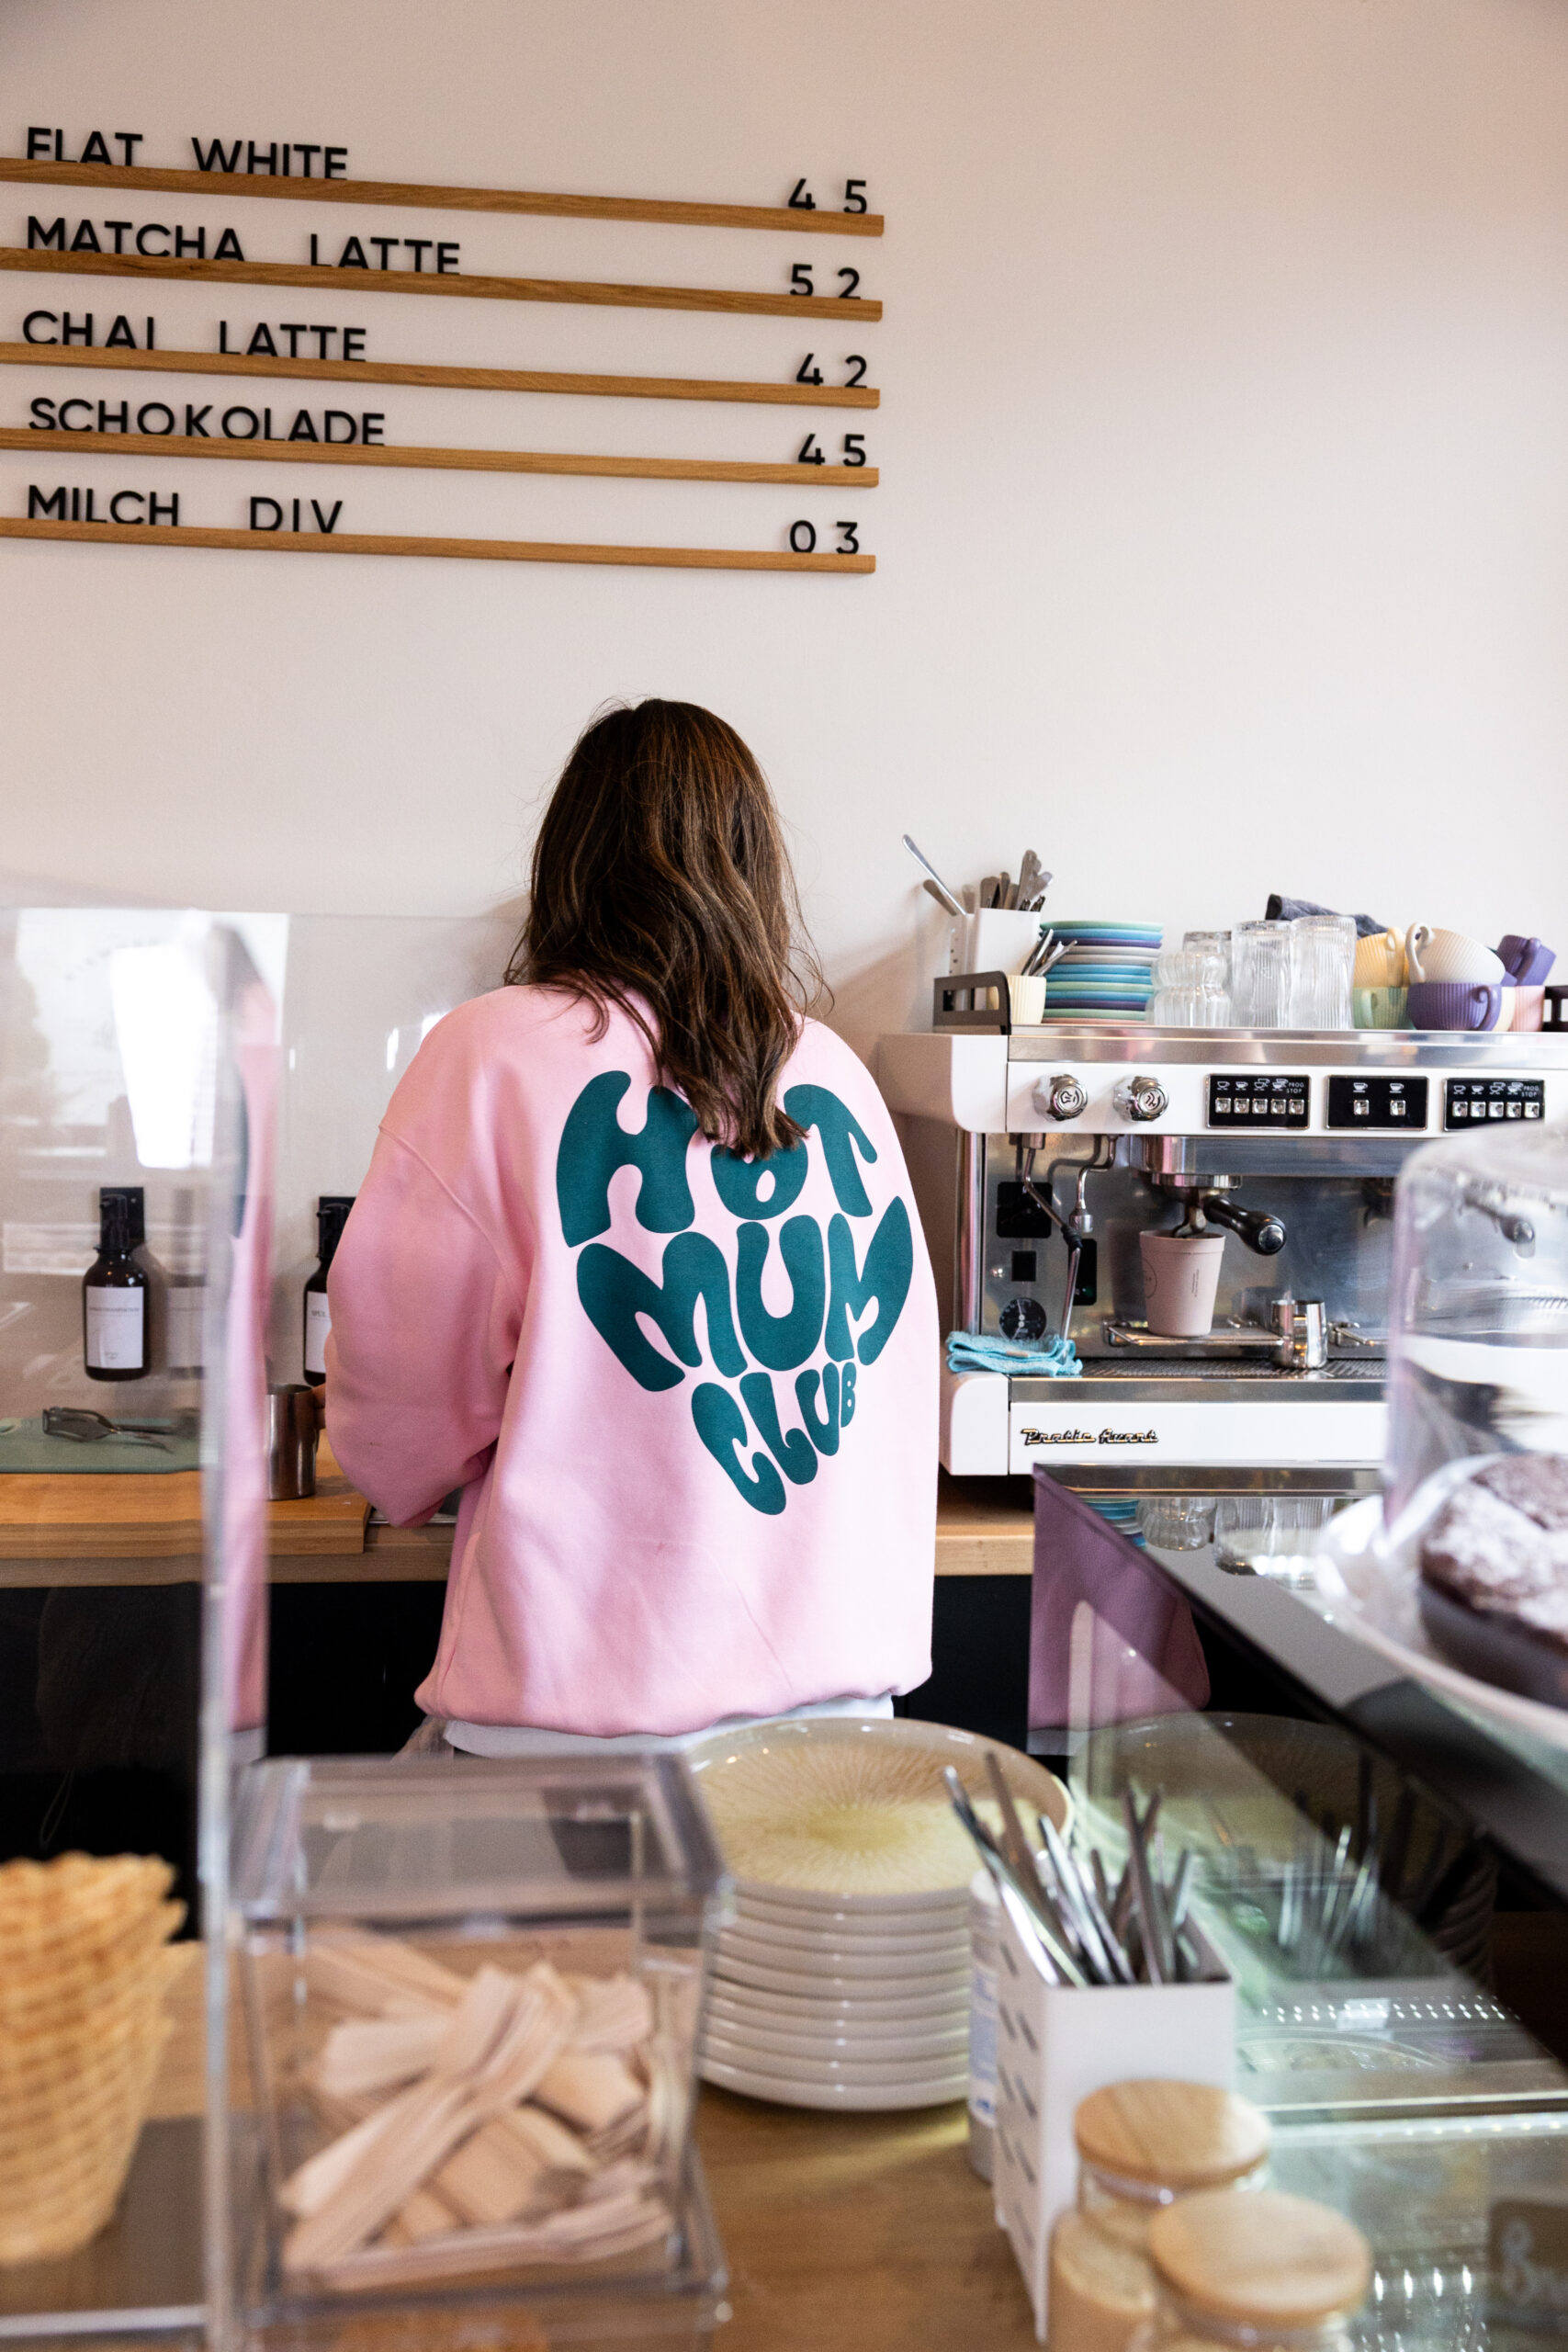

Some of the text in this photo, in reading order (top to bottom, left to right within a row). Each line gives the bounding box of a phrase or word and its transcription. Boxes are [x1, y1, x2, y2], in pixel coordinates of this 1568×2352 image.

[27, 127, 143, 167] FLAT
[191, 137, 348, 180] WHITE
[27, 216, 245, 262] MATCHA
[310, 233, 460, 276] LATTE
[22, 310, 154, 351] CHAI
[220, 321, 367, 363] LATTE
[28, 397, 385, 447] SCHOKOLADE
[28, 484, 179, 526] MILCH
[250, 496, 343, 534] DIV
[556, 1069, 878, 1248] HOT
[576, 1195, 914, 1392] MUM
[691, 1361, 857, 1516] CLUB
